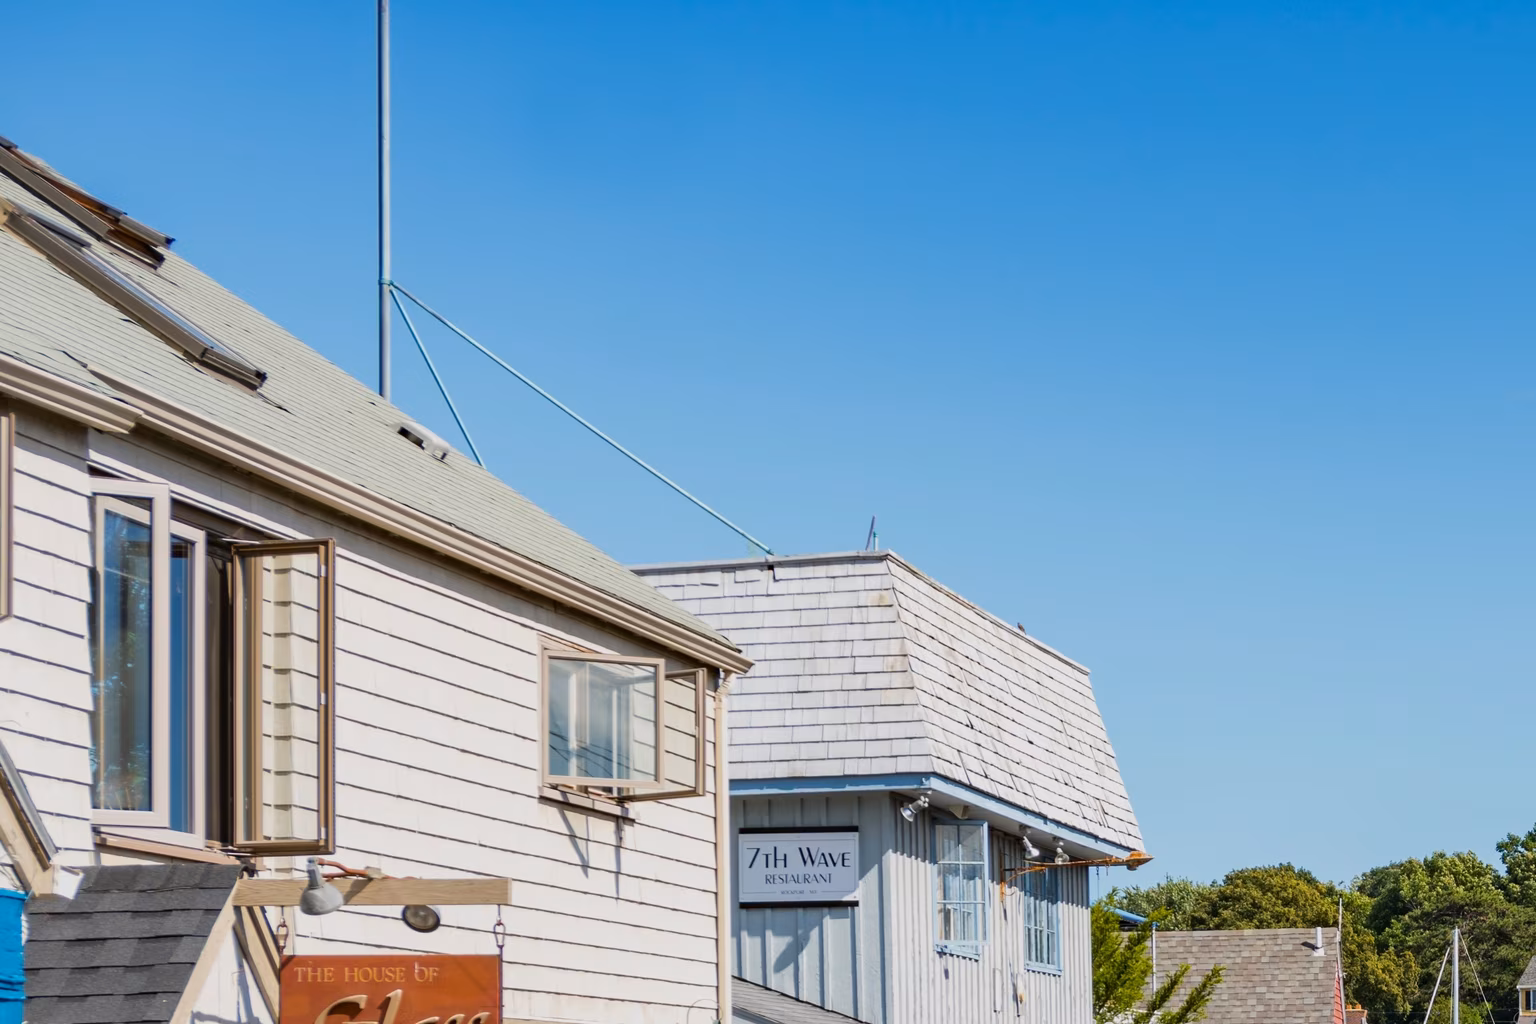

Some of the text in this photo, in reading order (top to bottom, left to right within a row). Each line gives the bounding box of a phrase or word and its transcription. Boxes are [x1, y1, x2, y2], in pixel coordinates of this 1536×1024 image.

[765, 873, 832, 885] RESTAURANT
[294, 966, 439, 983] THE HOUSE OF
